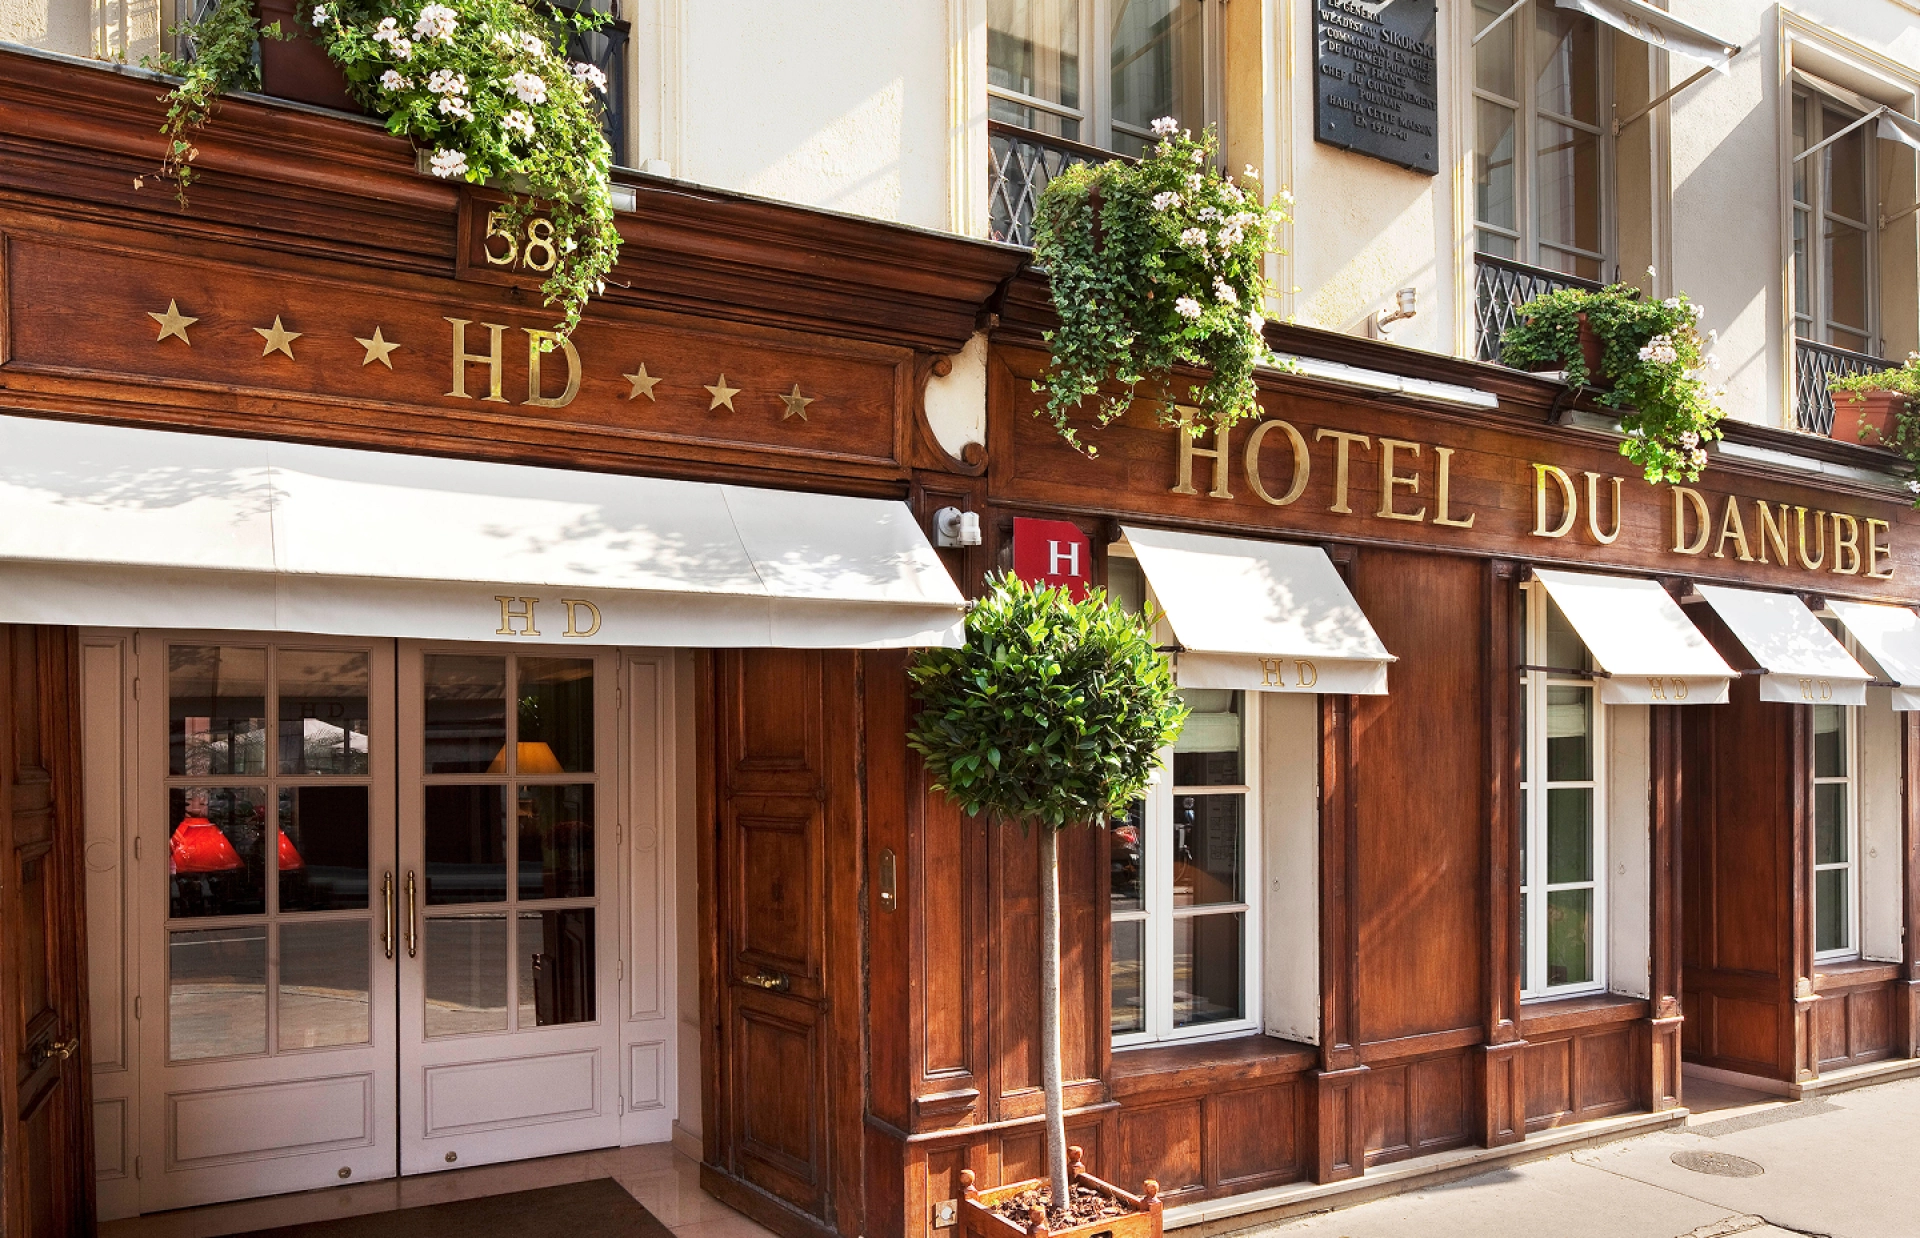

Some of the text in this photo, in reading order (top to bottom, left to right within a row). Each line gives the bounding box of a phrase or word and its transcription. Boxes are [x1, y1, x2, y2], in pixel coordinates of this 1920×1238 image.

[1327, 27, 1391, 58] COMMANDANT
[1328, 40, 1341, 53] DE
[1380, 28, 1436, 60] SIKORSKI
[1321, 63, 1346, 79] CHEF
[1350, 73, 1364, 85] DU
[1371, 67, 1407, 88] FRANCE
[1329, 94, 1364, 114] HABITA
[1367, 106, 1396, 124] CETTE
[1360, 89, 1402, 112] POLONAIS
[484, 211, 557, 272] 58
[443, 316, 582, 409] HD
[1171, 404, 1894, 579] HOTEL DU DANUBE
[1047, 539, 1081, 577] H
